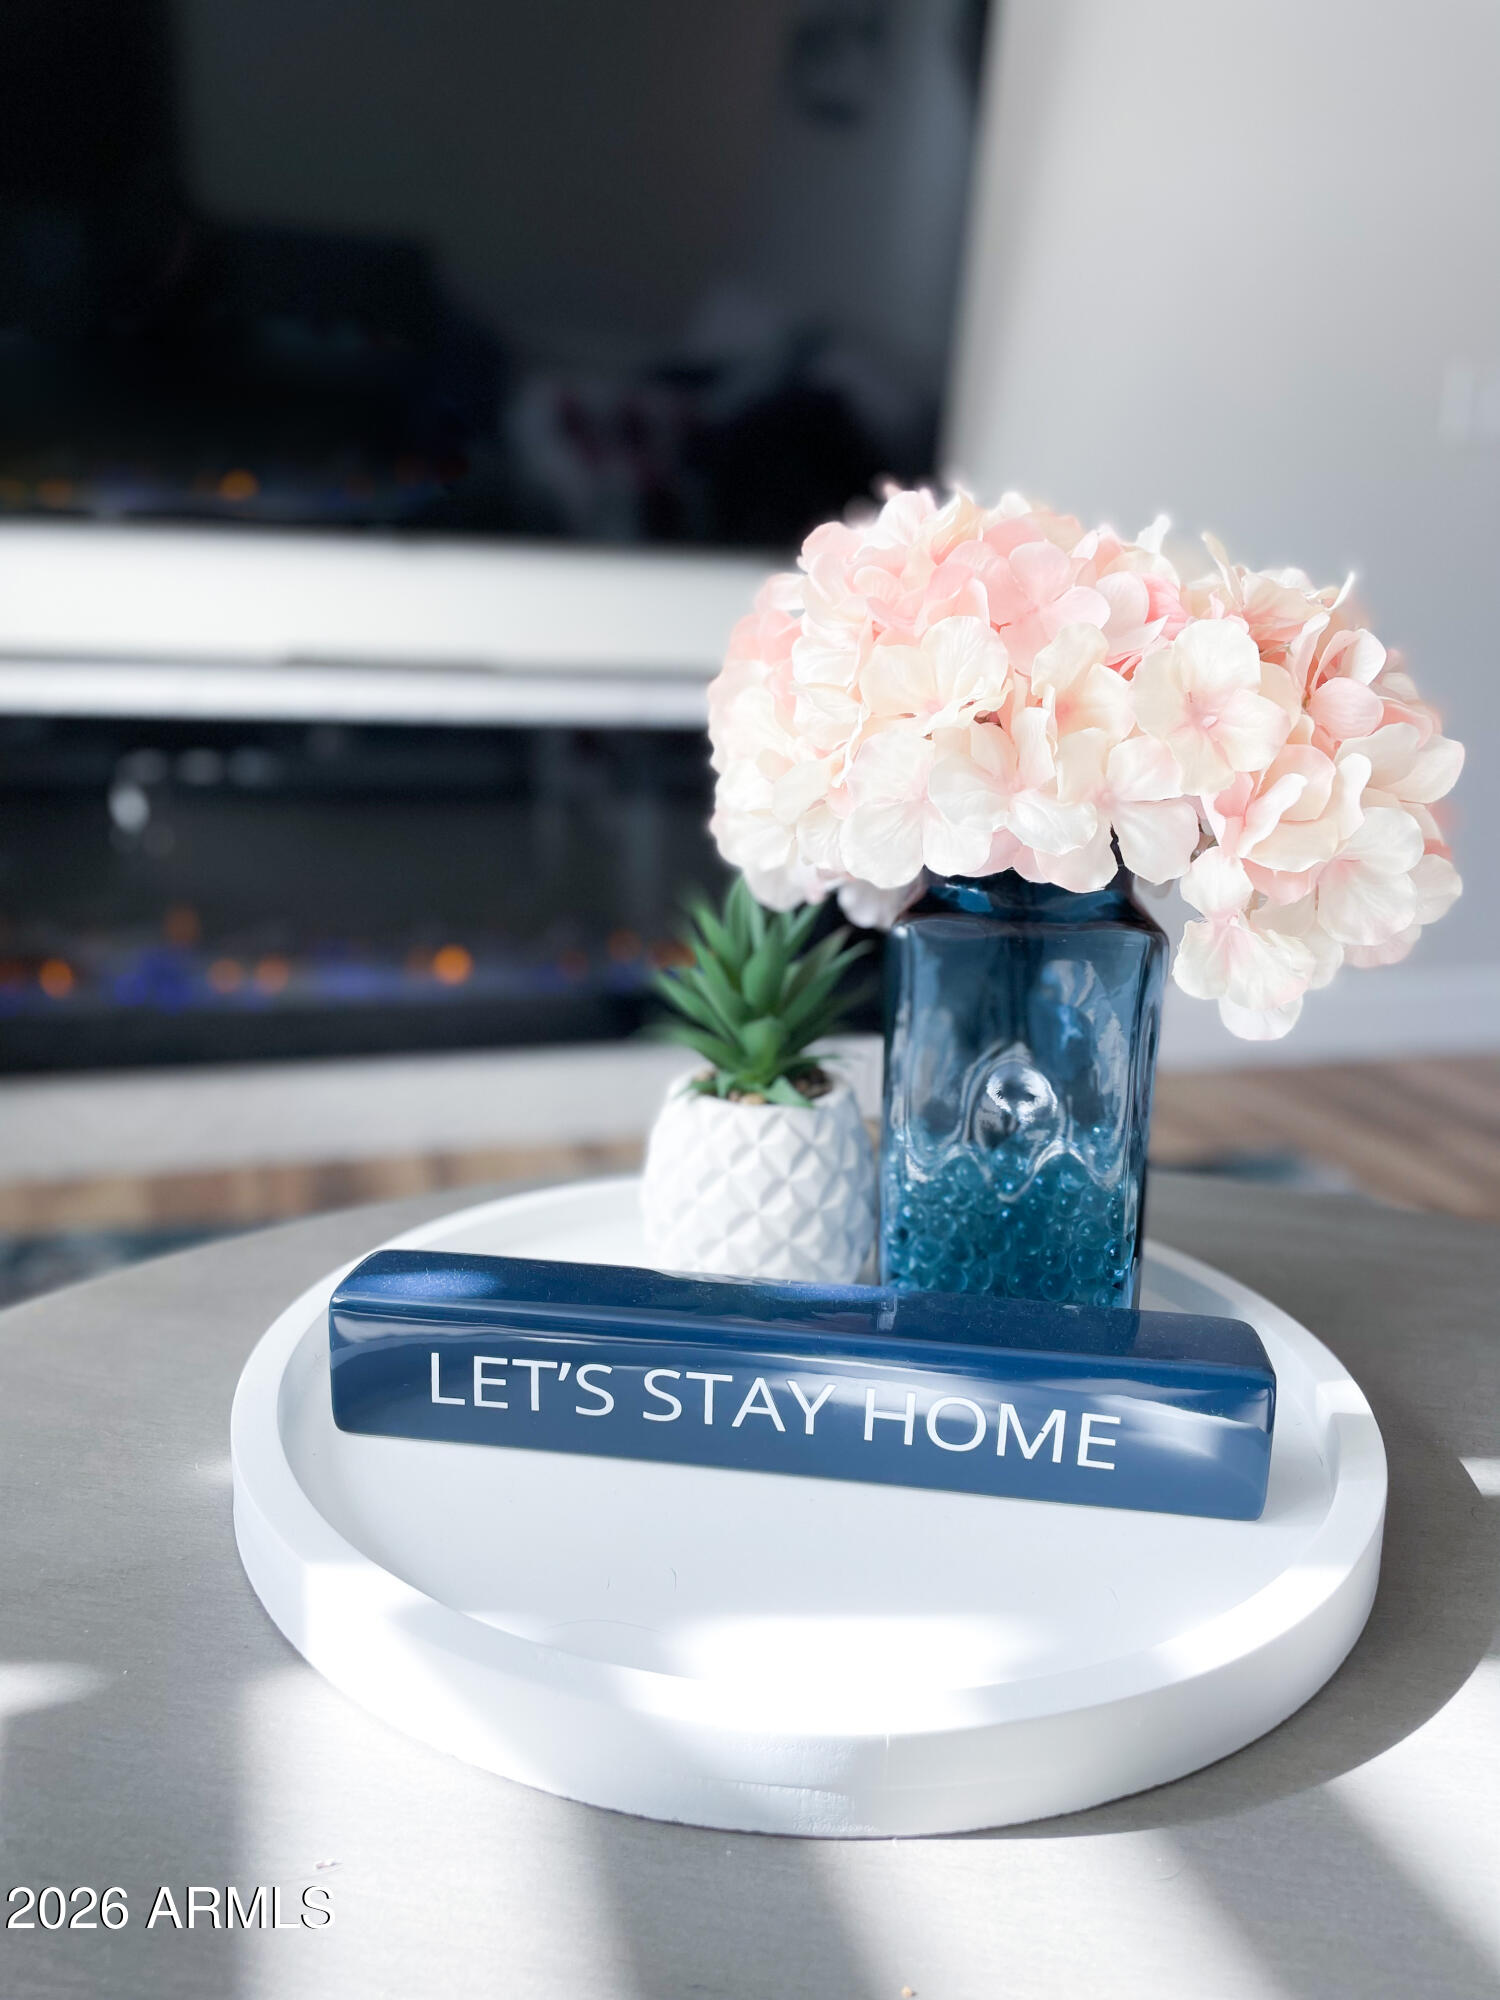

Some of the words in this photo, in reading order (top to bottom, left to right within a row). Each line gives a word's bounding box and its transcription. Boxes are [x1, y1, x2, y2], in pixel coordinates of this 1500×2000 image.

[430, 1352, 614, 1417] LET'S
[642, 1368, 837, 1436] STAY
[863, 1387, 1122, 1471] HOME
